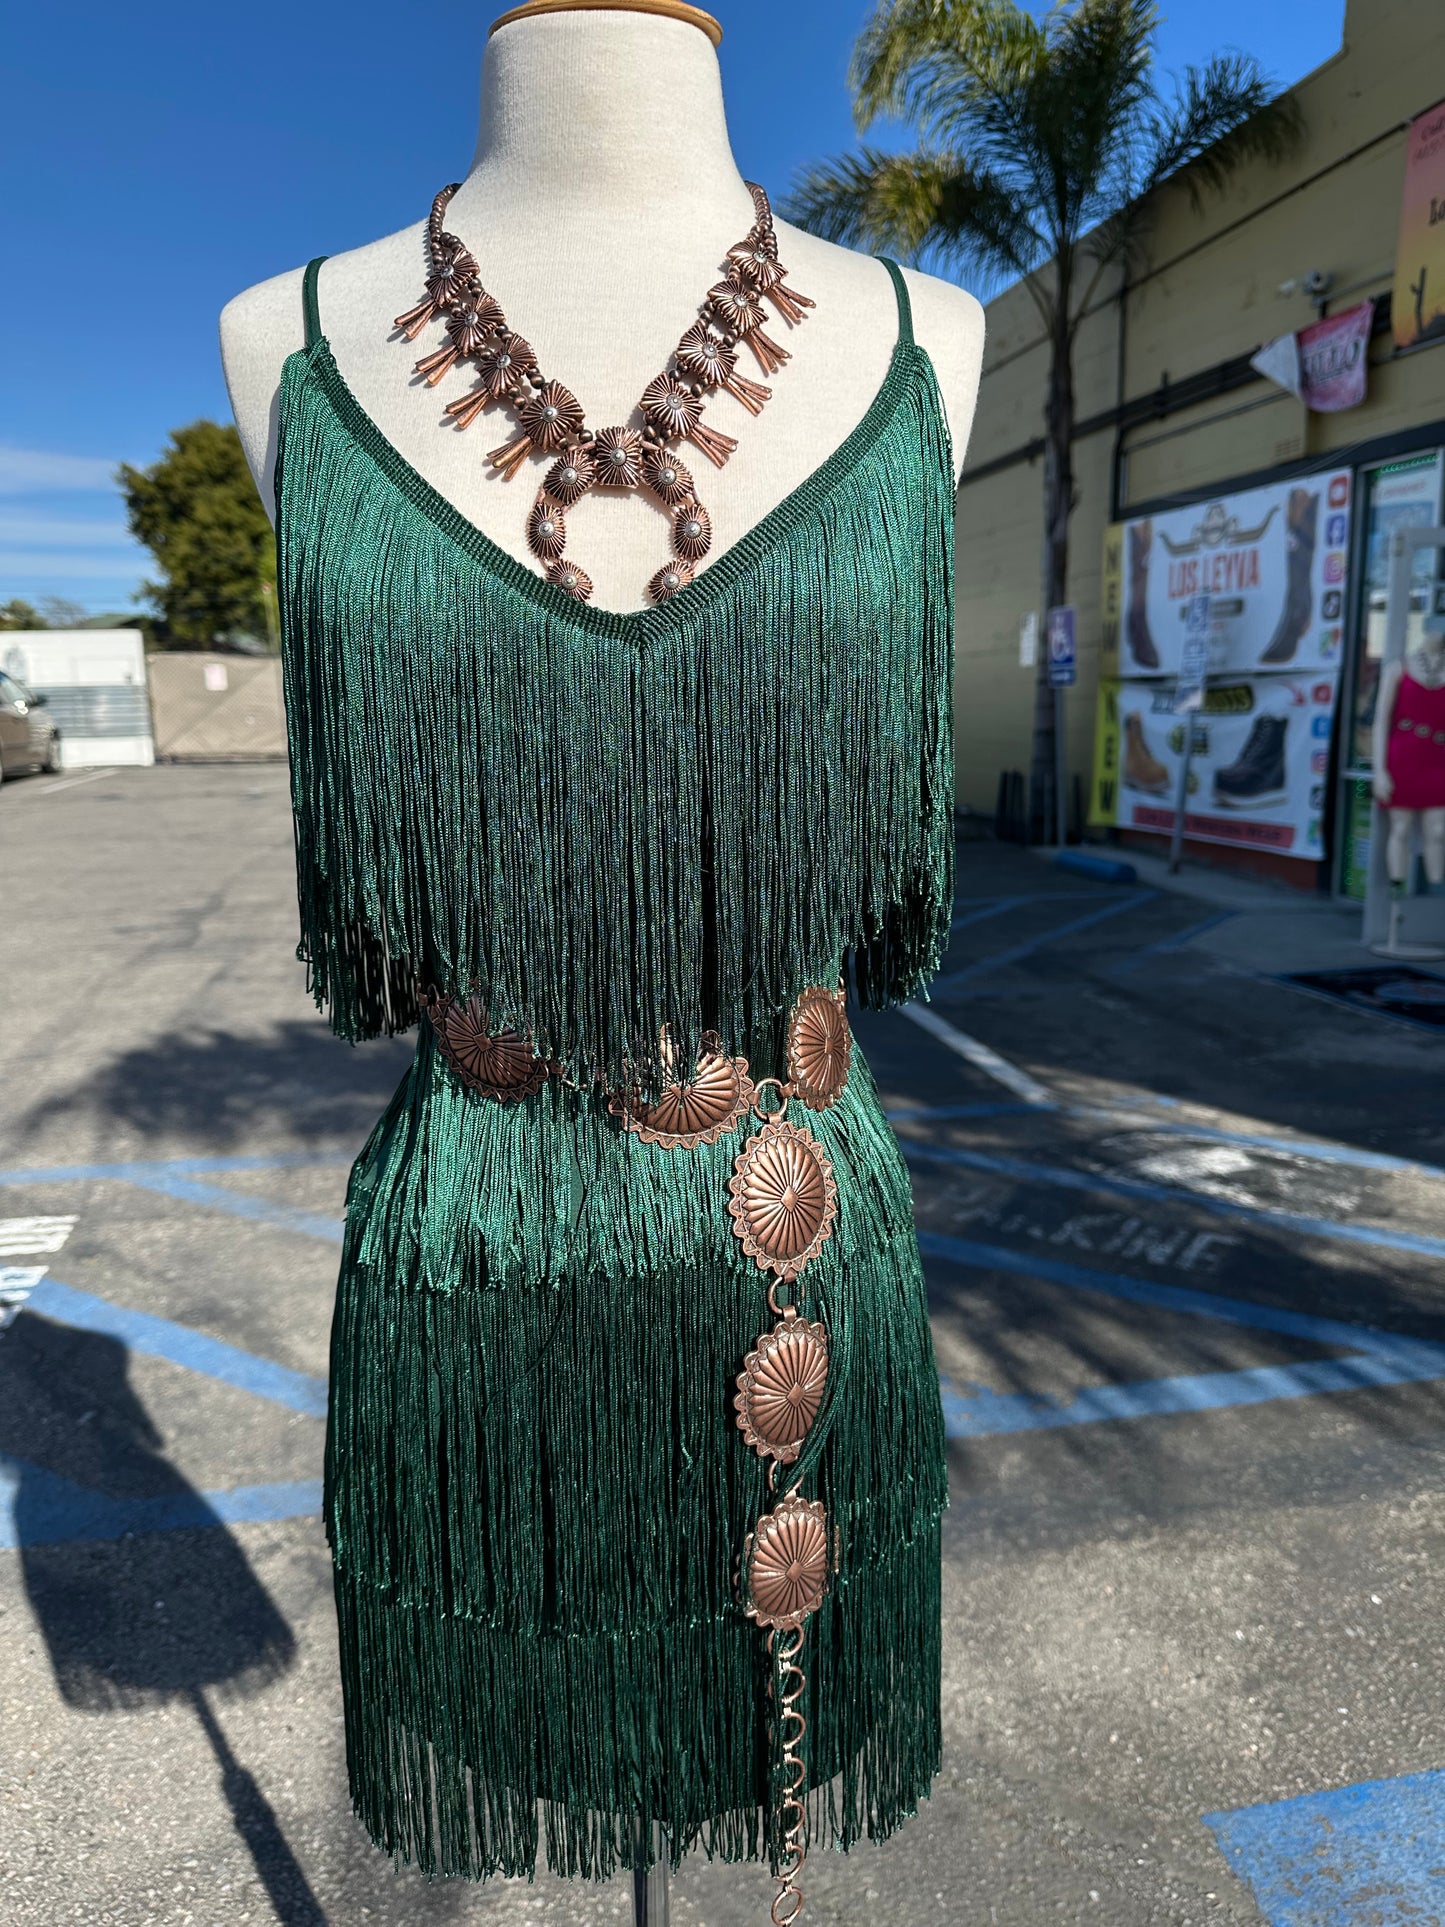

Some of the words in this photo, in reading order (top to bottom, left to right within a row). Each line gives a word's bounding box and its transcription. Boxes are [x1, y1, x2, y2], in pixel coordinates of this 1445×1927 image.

[1102, 543, 1119, 653] NEW
[1168, 560, 1198, 599] LOS
[1202, 549, 1260, 593] LEYVA
[1099, 690, 1116, 812] NEW
